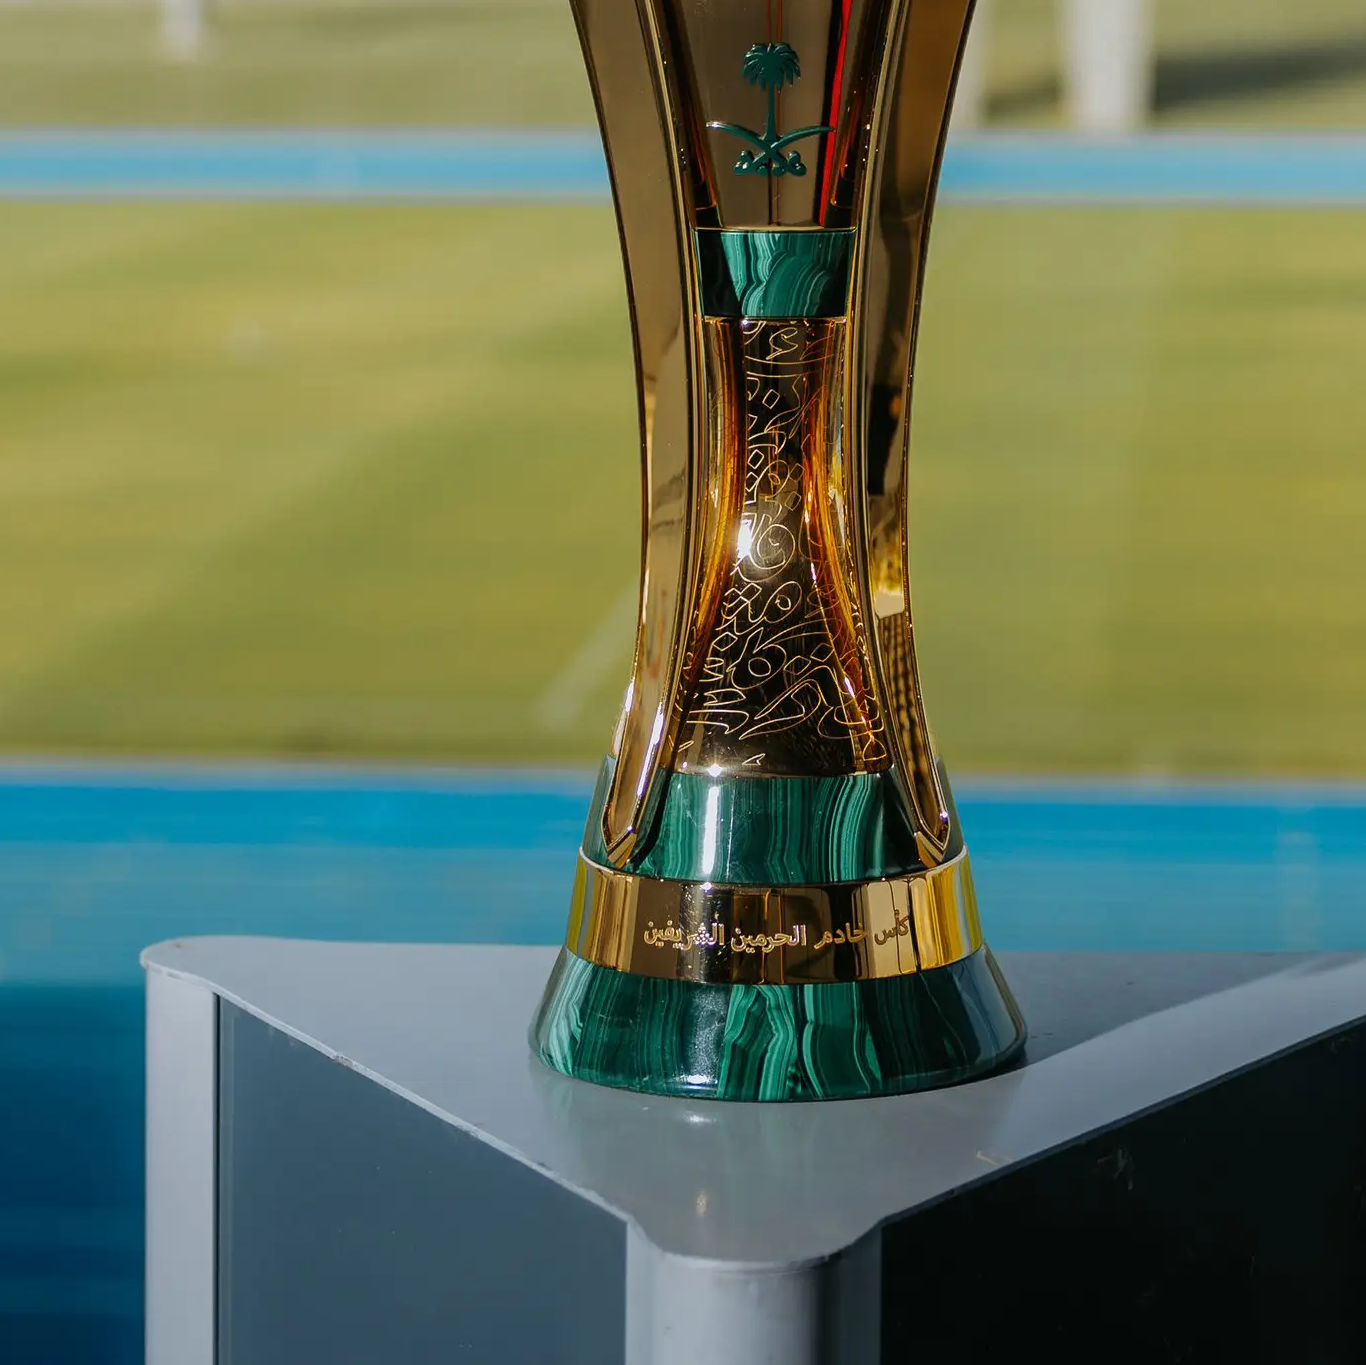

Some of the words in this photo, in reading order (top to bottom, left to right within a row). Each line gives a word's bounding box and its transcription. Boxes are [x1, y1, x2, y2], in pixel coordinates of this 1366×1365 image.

[643, 920, 725, 951] الشريفين
[730, 924, 806, 953] الحرمين
[813, 922, 867, 950] خادم
[874, 909, 910, 946] كأس
